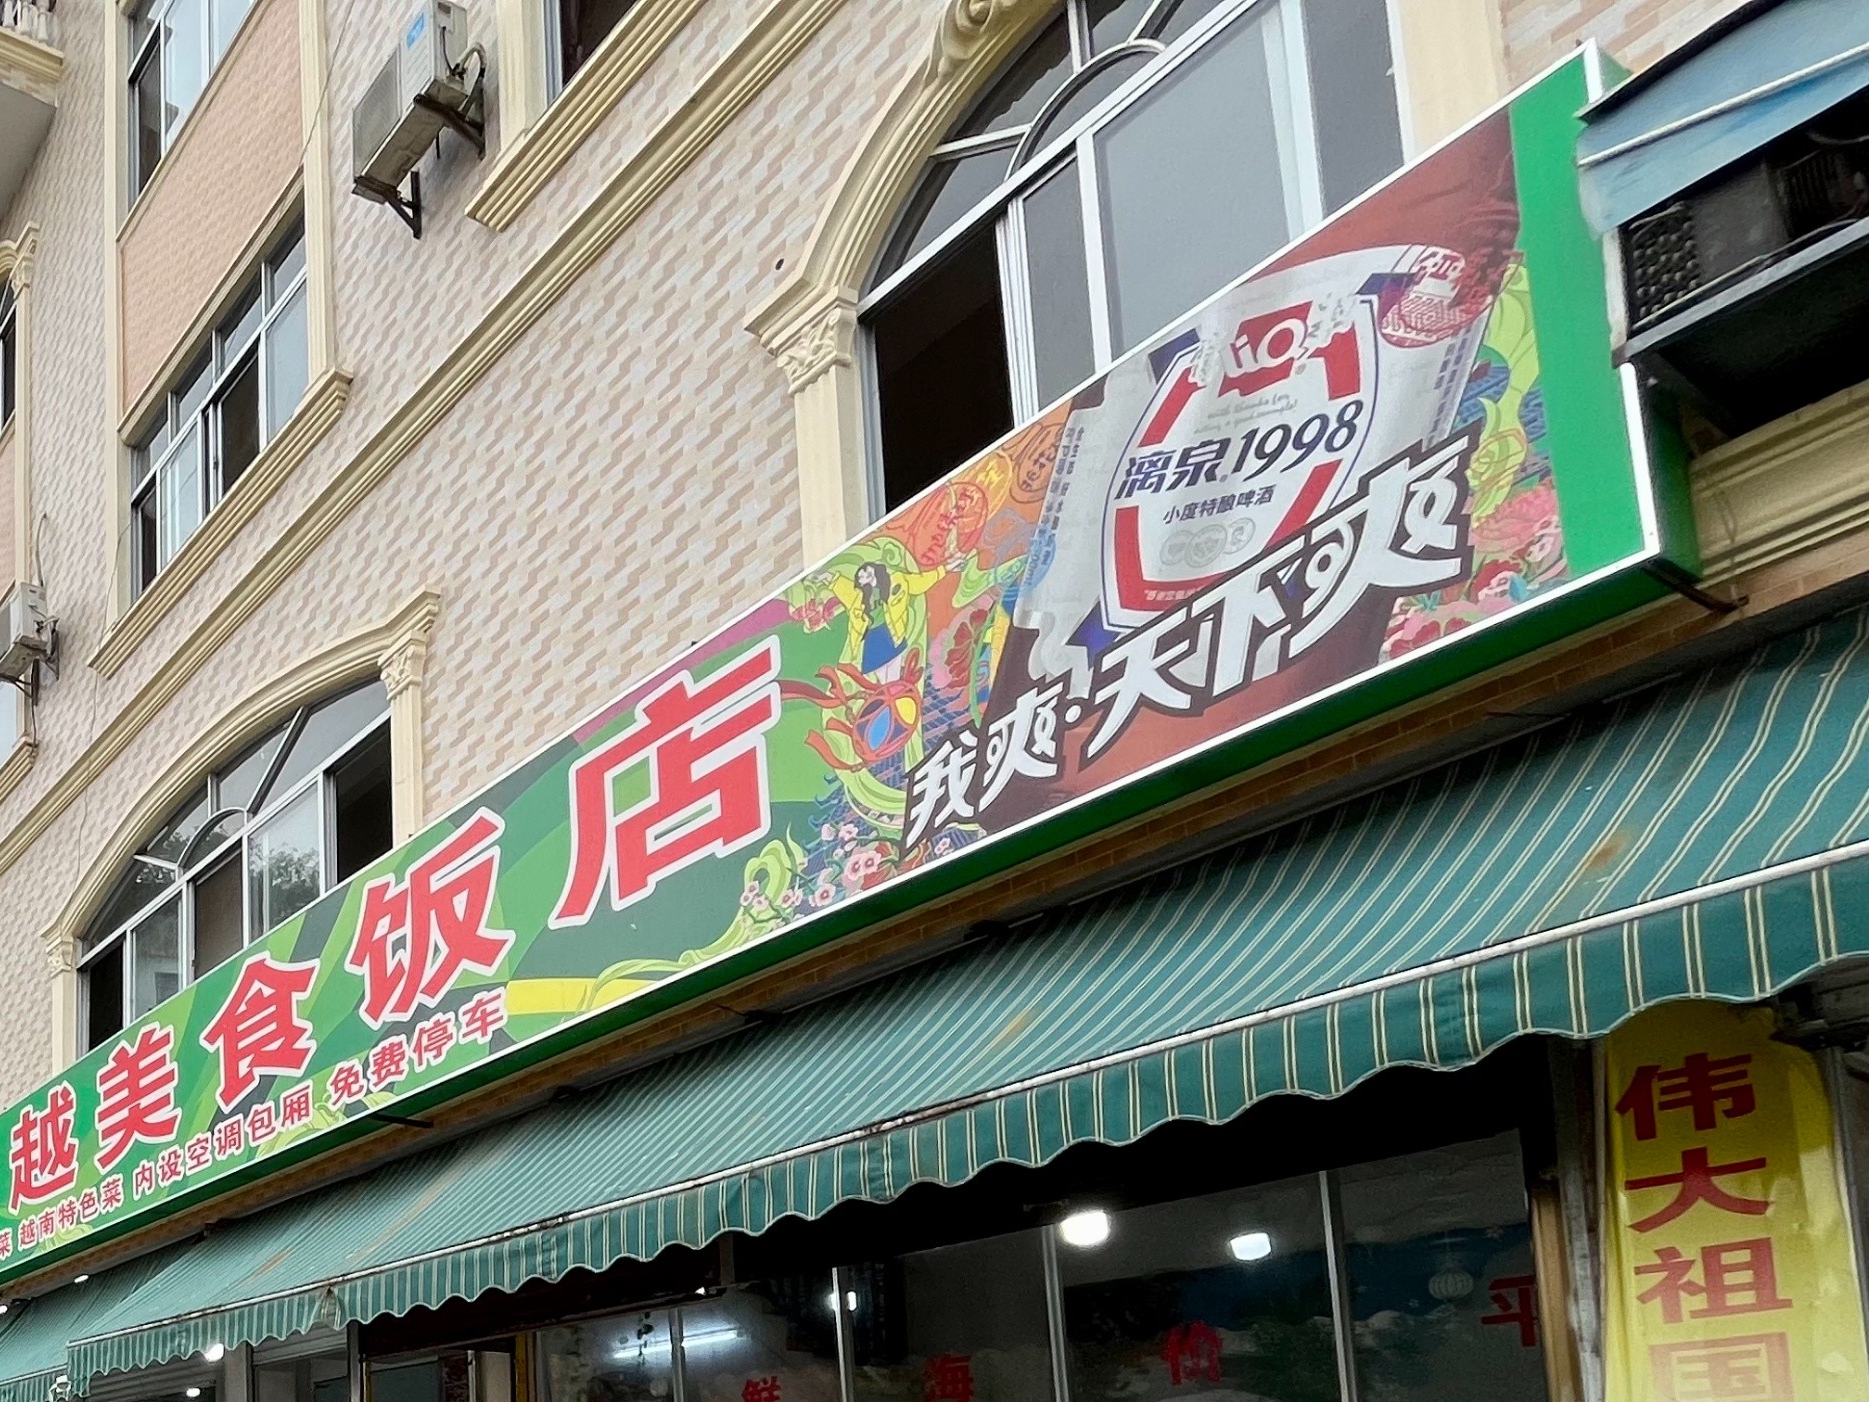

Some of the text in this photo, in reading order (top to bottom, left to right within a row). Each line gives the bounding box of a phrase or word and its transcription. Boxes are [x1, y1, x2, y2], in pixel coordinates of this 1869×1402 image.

[1163, 484, 1277, 524] 小度特酿啤酒
[18, 1178, 123, 1249] 越南特色菜
[134, 1084, 313, 1197] 内设空调包厢
[329, 992, 506, 1106] 免费停车
